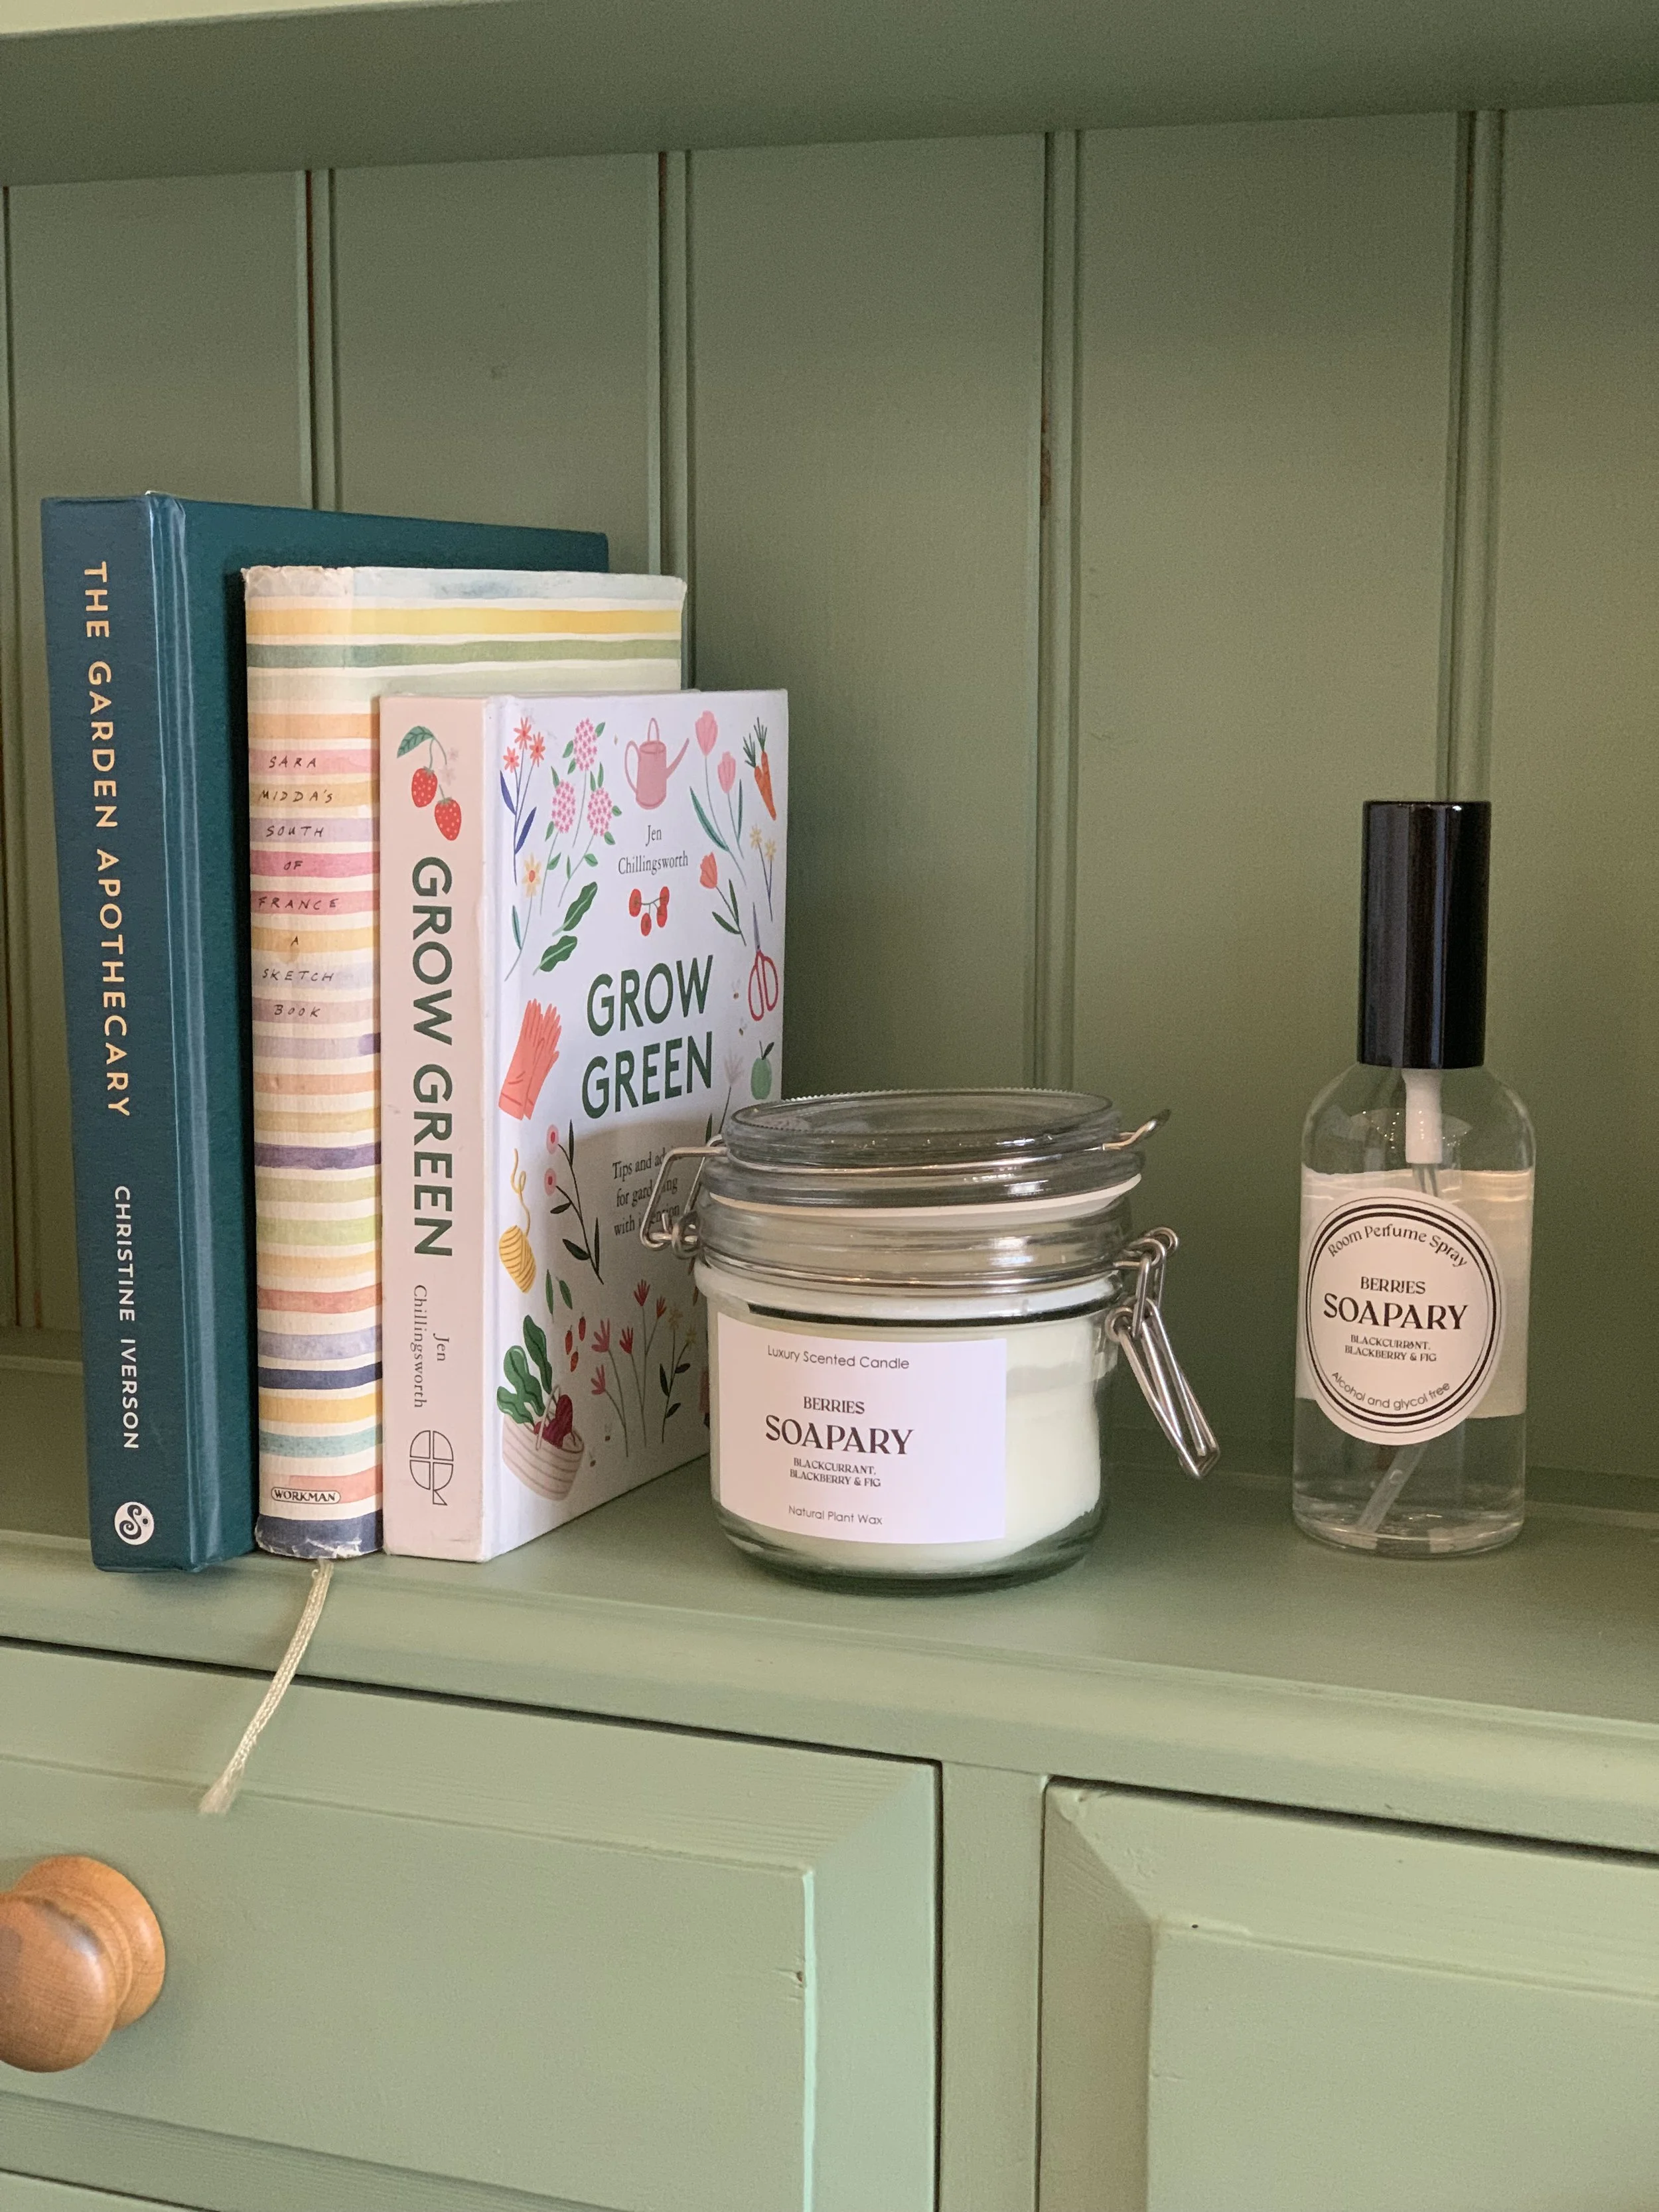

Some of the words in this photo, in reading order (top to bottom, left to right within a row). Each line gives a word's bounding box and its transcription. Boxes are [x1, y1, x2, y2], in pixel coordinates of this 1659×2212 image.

[84, 561, 109, 638] THE
[88, 661, 118, 827] GARDEN
[269, 755, 317, 769] SARA
[266, 826, 324, 838] SOUTH
[645, 825, 662, 847] Jen
[283, 861, 303, 871] OF
[618, 850, 689, 875] Chillingsworth
[258, 897, 339, 910] FRANCE
[291, 936, 299, 946] A
[412, 857, 453, 1046] GROW
[97, 849, 130, 1116] APOTHECARY
[262, 968, 334, 982] SKETCH
[587, 954, 713, 1037] GROW
[274, 1004, 321, 1017] BOOK
[582, 1031, 712, 1119] GREEN
[413, 1063, 453, 1257] GREEN
[613, 1160, 632, 1182] Tips
[635, 1151, 652, 1173] and
[616, 1188, 629, 1207] for
[614, 1215, 635, 1236] with
[115, 1186, 135, 1321] CHRISTINE
[1327, 1229, 1363, 1257] Room
[1364, 1223, 1427, 1242] Perfume
[1429, 1234, 1468, 1268] Spray
[1360, 1276, 1426, 1295] BERRIES
[1323, 1293, 1469, 1330] SOAPARY
[410, 1285, 427, 1408] Chillingsworth
[433, 1333, 450, 1362] Jen
[768, 1345, 800, 1363] Luxury
[803, 1351, 855, 1367] Scented
[860, 1356, 910, 1369] Candle
[1344, 1345, 1406, 1361] BLACKBERRY
[1409, 1353, 1417, 1361] &
[1419, 1353, 1437, 1362] FIG
[121, 1339, 139, 1449] IVERSON
[1332, 1372, 1366, 1402] Alcohol
[1367, 1396, 1390, 1409] and
[1394, 1394, 1428, 1412] glycol
[1428, 1382, 1451, 1400] free
[804, 1396, 865, 1414] BERRIES
[766, 1414, 914, 1455] SOAPARY
[790, 1469, 851, 1485] BLACKBERRY
[853, 1477, 861, 1486] &
[864, 1478, 881, 1487] FIG
[794, 1457, 876, 1475] BLACKCURRANT,
[273, 1489, 336, 1502] WORKMAN
[788, 1505, 824, 1520] Natural
[828, 1511, 854, 1523] Plant
[857, 1514, 883, 1525] Wax
